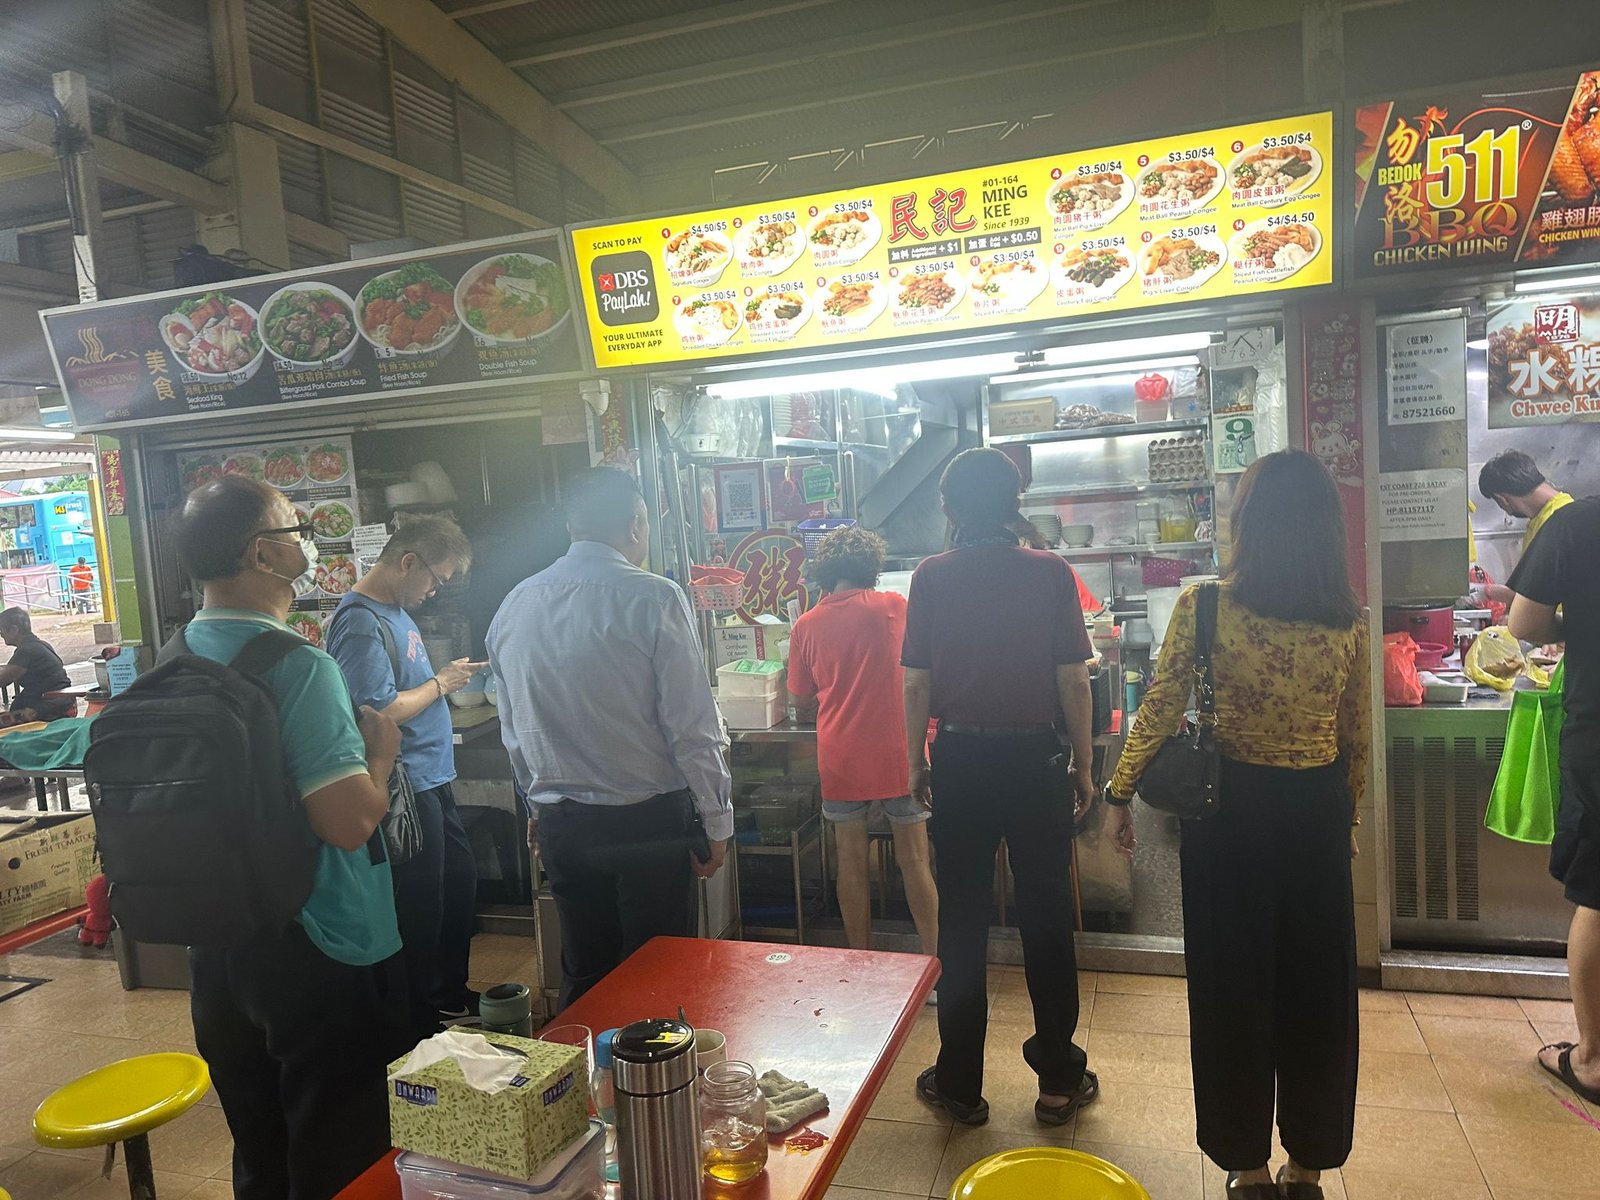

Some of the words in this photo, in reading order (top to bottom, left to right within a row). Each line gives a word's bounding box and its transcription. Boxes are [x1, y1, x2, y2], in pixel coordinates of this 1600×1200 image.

[1263, 132, 1312, 149] $3.50/$4
[1168, 148, 1214, 162] $3.50/$4
[1078, 161, 1122, 176] $3.50/$4
[1426, 125, 1520, 209] 511
[982, 175, 1018, 187] #01-164
[1378, 164, 1422, 186] BEDOK
[983, 185, 1027, 204] MING
[834, 200, 872, 213] $3.50/$4
[984, 204, 1011, 219] KEE
[1193, 207, 1217, 215] Congee
[759, 212, 796, 224] $3.50/$4
[888, 188, 978, 242] 民記
[1268, 212, 1314, 226] $4/$4.50
[692, 222, 726, 234] $4.50/$5
[984, 221, 1006, 231] Since
[1010, 217, 1030, 226] 1939
[1378, 200, 1518, 248] BBQ
[1011, 231, 1038, 244] $0.50
[1171, 225, 1216, 238] $3.50/$4
[1539, 230, 1579, 243] CHICKEN
[593, 240, 613, 250] SCAN
[615, 239, 626, 248] TO
[628, 237, 642, 246] PAY
[947, 242, 958, 253] $1
[1082, 237, 1124, 251] $3.50/$4
[994, 250, 1034, 264] $3.50/$4
[1374, 243, 1450, 267] CHICKEN
[1456, 236, 1508, 257] WING
[915, 262, 954, 274] $3.50/$4
[614, 270, 648, 290] DBS
[842, 272, 879, 284] $3.50/$4
[601, 289, 650, 313] PayLah!
[1540, 306, 1576, 329] 明
[603, 332, 624, 342] YOUR
[626, 330, 663, 340] ULTIMATE
[608, 342, 646, 352] EVERYDAY
[648, 340, 662, 349] APP
[480, 362, 504, 370] Double
[520, 359, 536, 367] Soup
[145, 350, 176, 400] 美食
[326, 380, 349, 388] Combo
[350, 378, 366, 386] Soup
[186, 396, 210, 404] Seafood
[1402, 406, 1456, 418] 87521660
[1512, 400, 1570, 417] Chwee
[25, 846, 52, 860] FRESH
